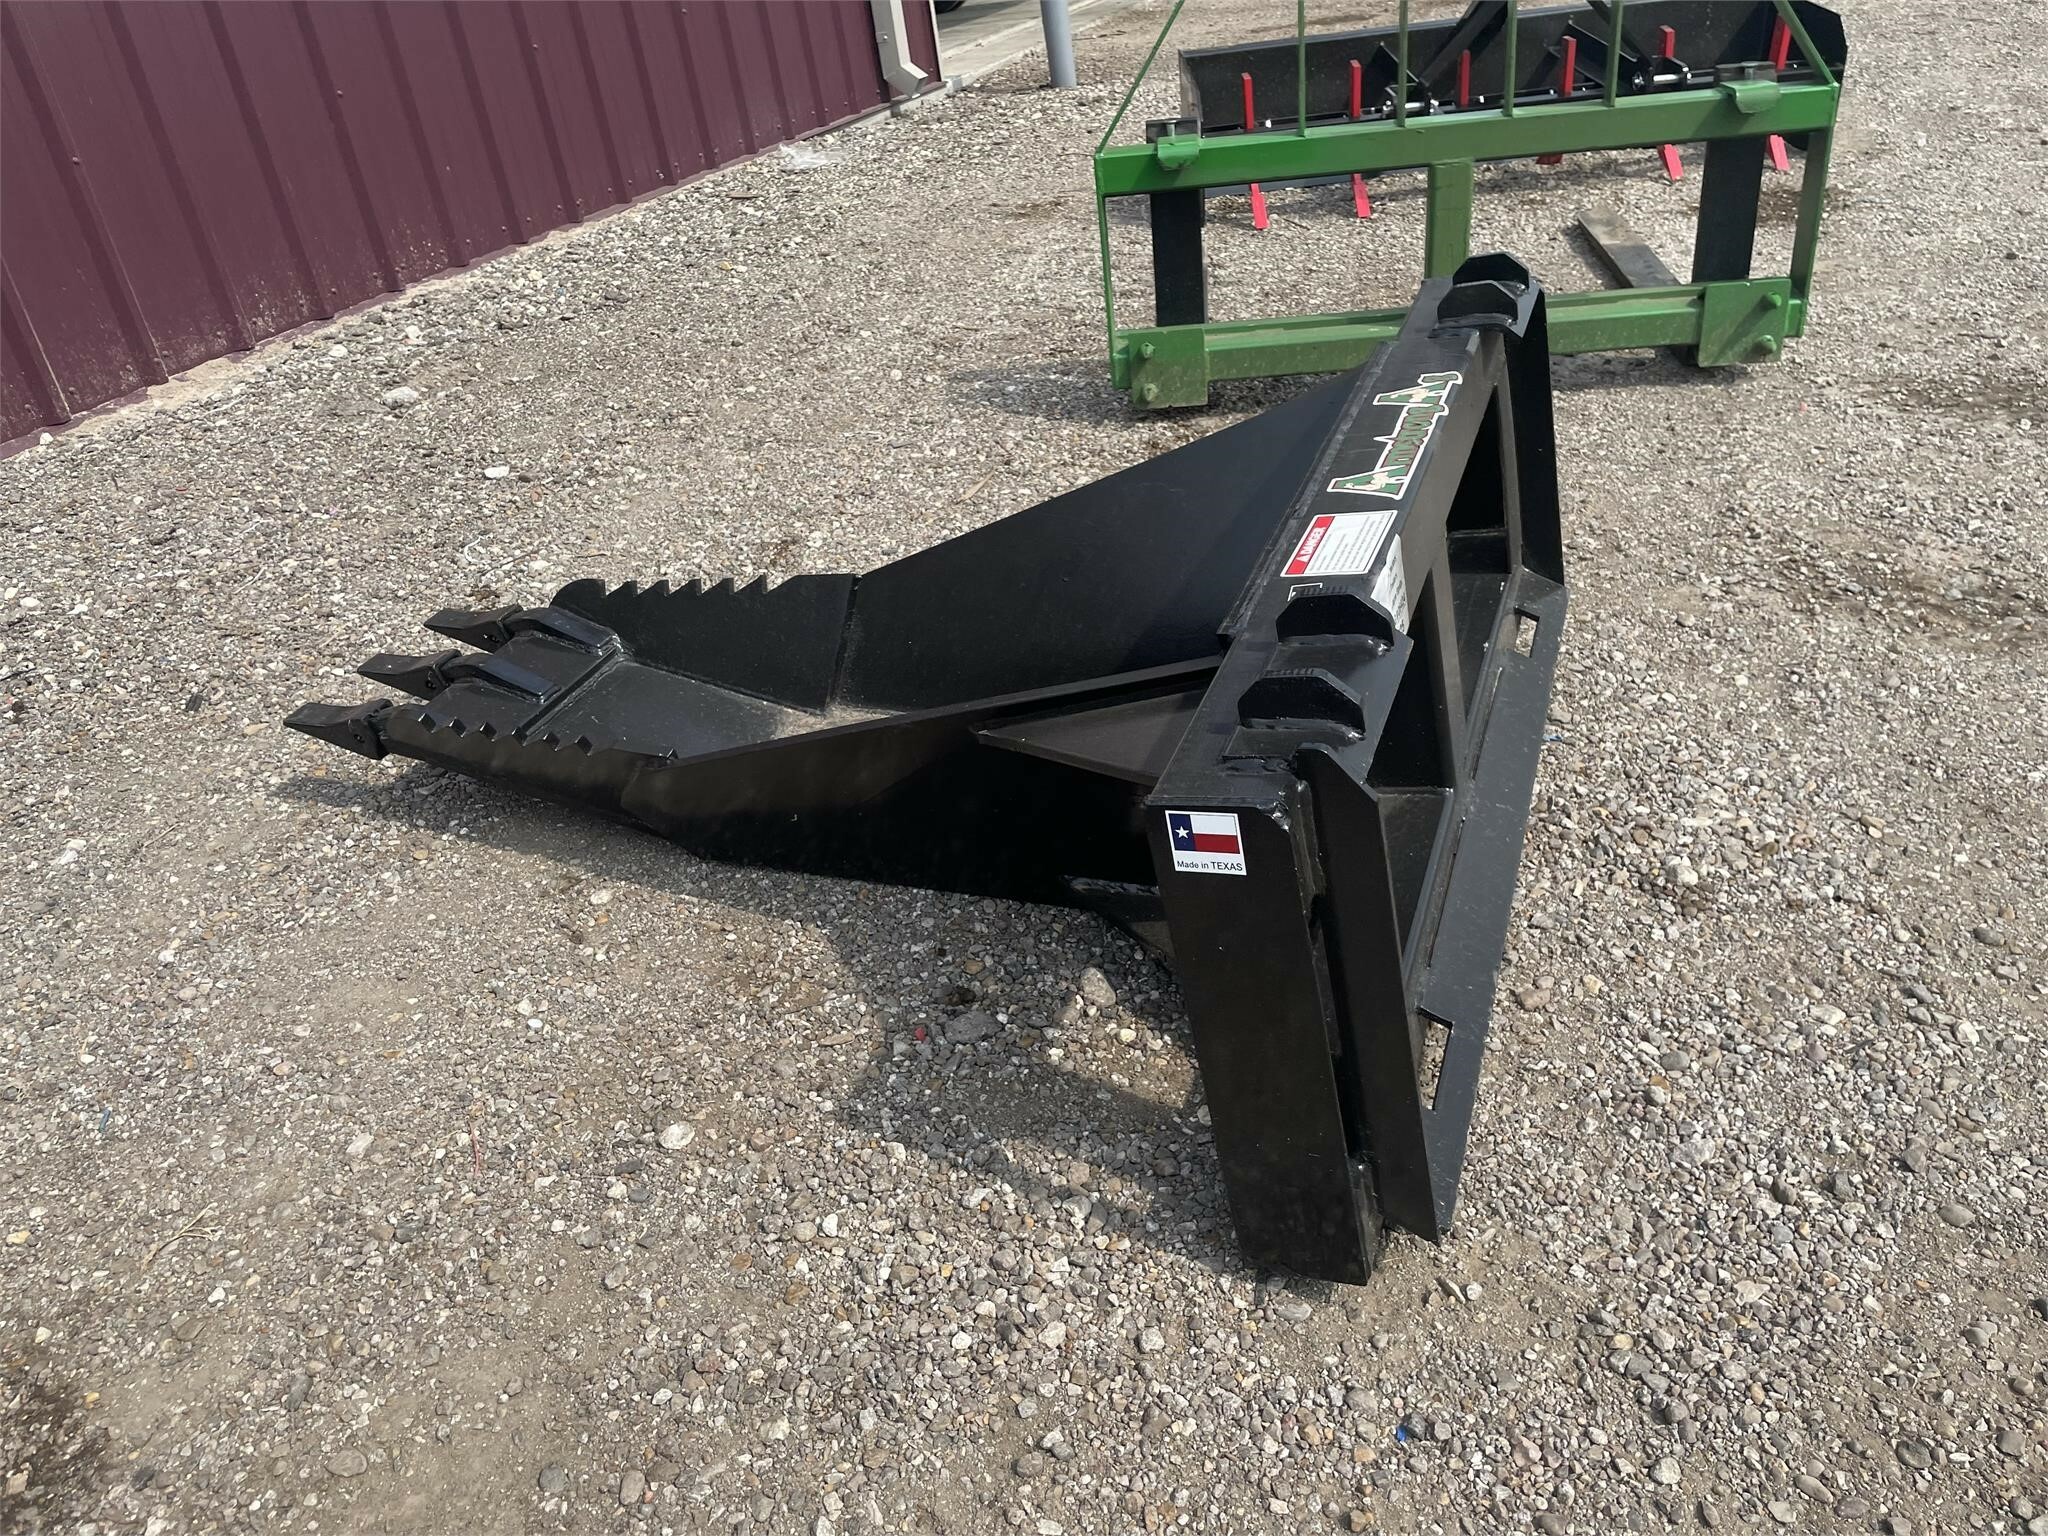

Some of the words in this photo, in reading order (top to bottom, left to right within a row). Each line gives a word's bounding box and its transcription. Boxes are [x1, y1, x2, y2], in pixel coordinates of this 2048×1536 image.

[1177, 860, 1199, 869] Made
[1201, 861, 1209, 870] in
[1210, 861, 1243, 871] TEXAS
